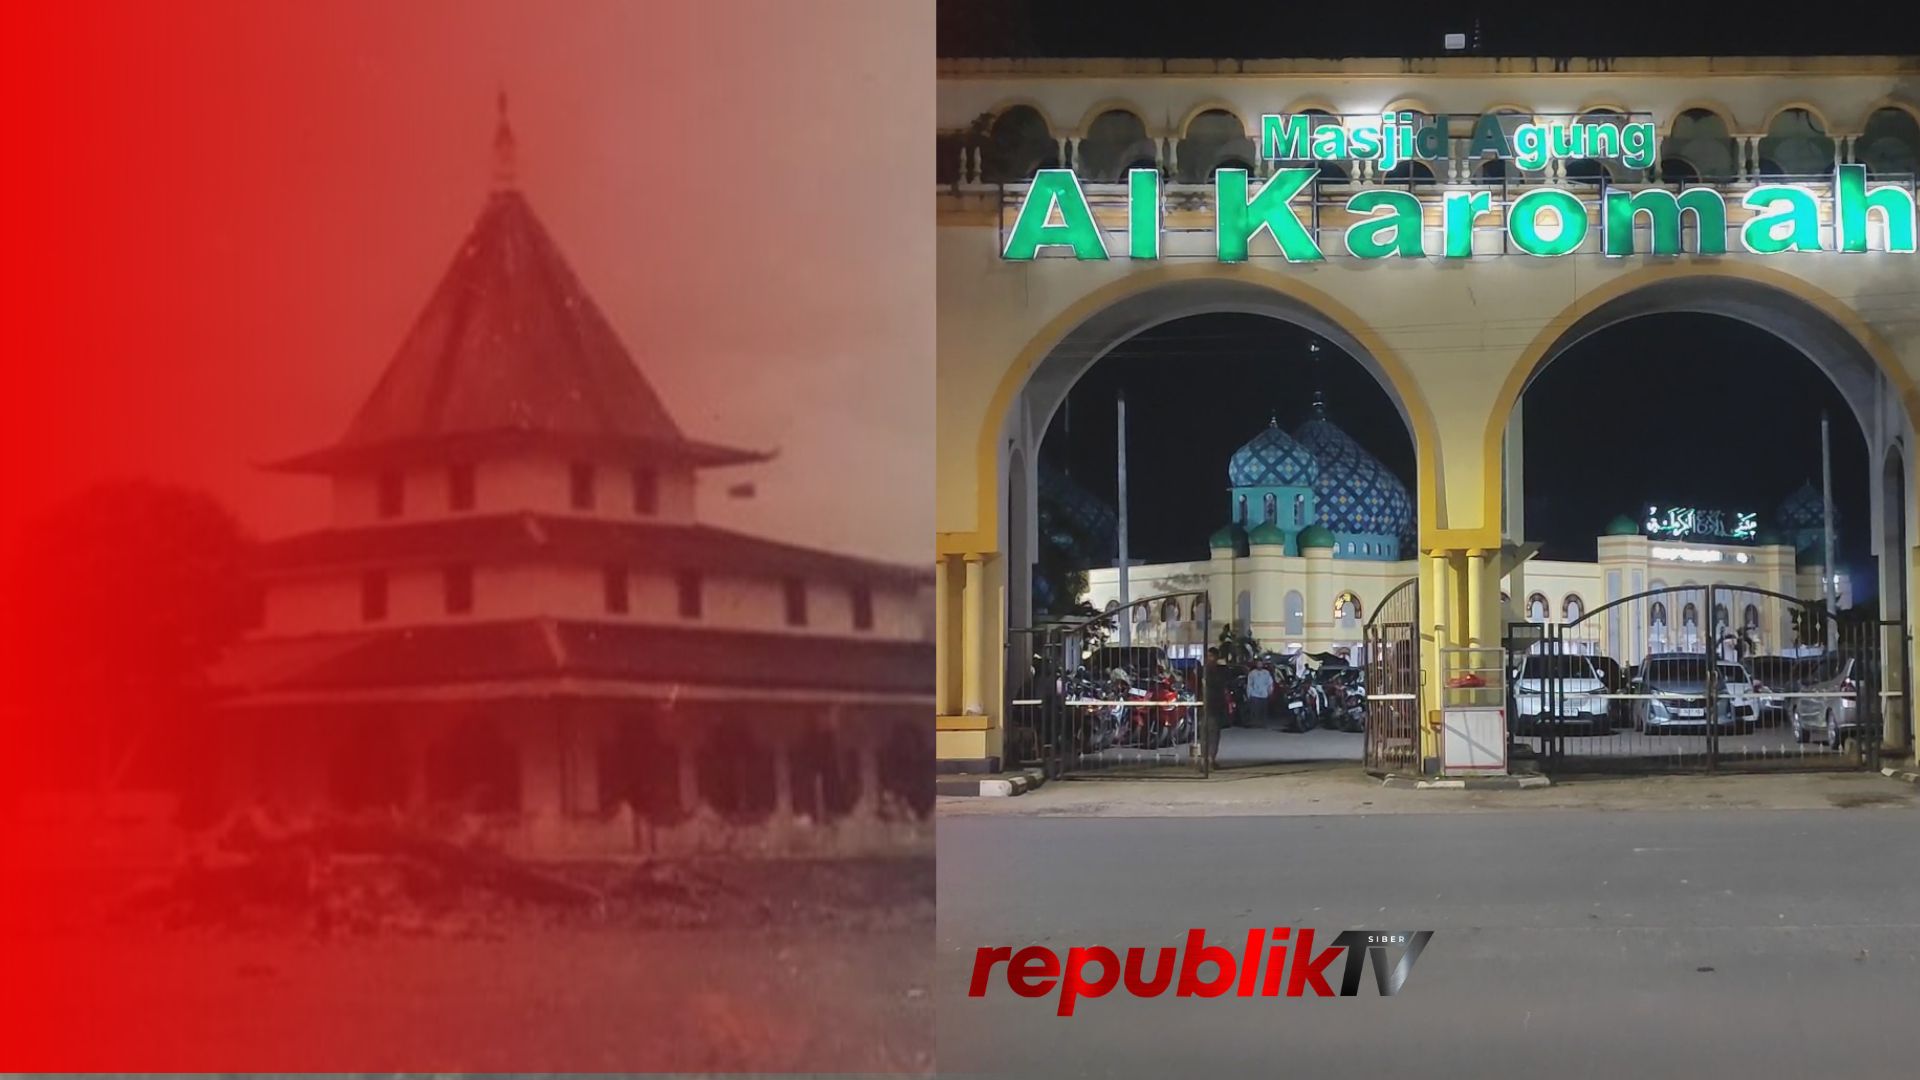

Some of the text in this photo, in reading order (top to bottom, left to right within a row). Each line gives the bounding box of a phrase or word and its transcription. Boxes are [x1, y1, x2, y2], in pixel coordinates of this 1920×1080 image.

[1261, 112, 1655, 171] Masjid Agung
[1215, 163, 1917, 264] Karomah
